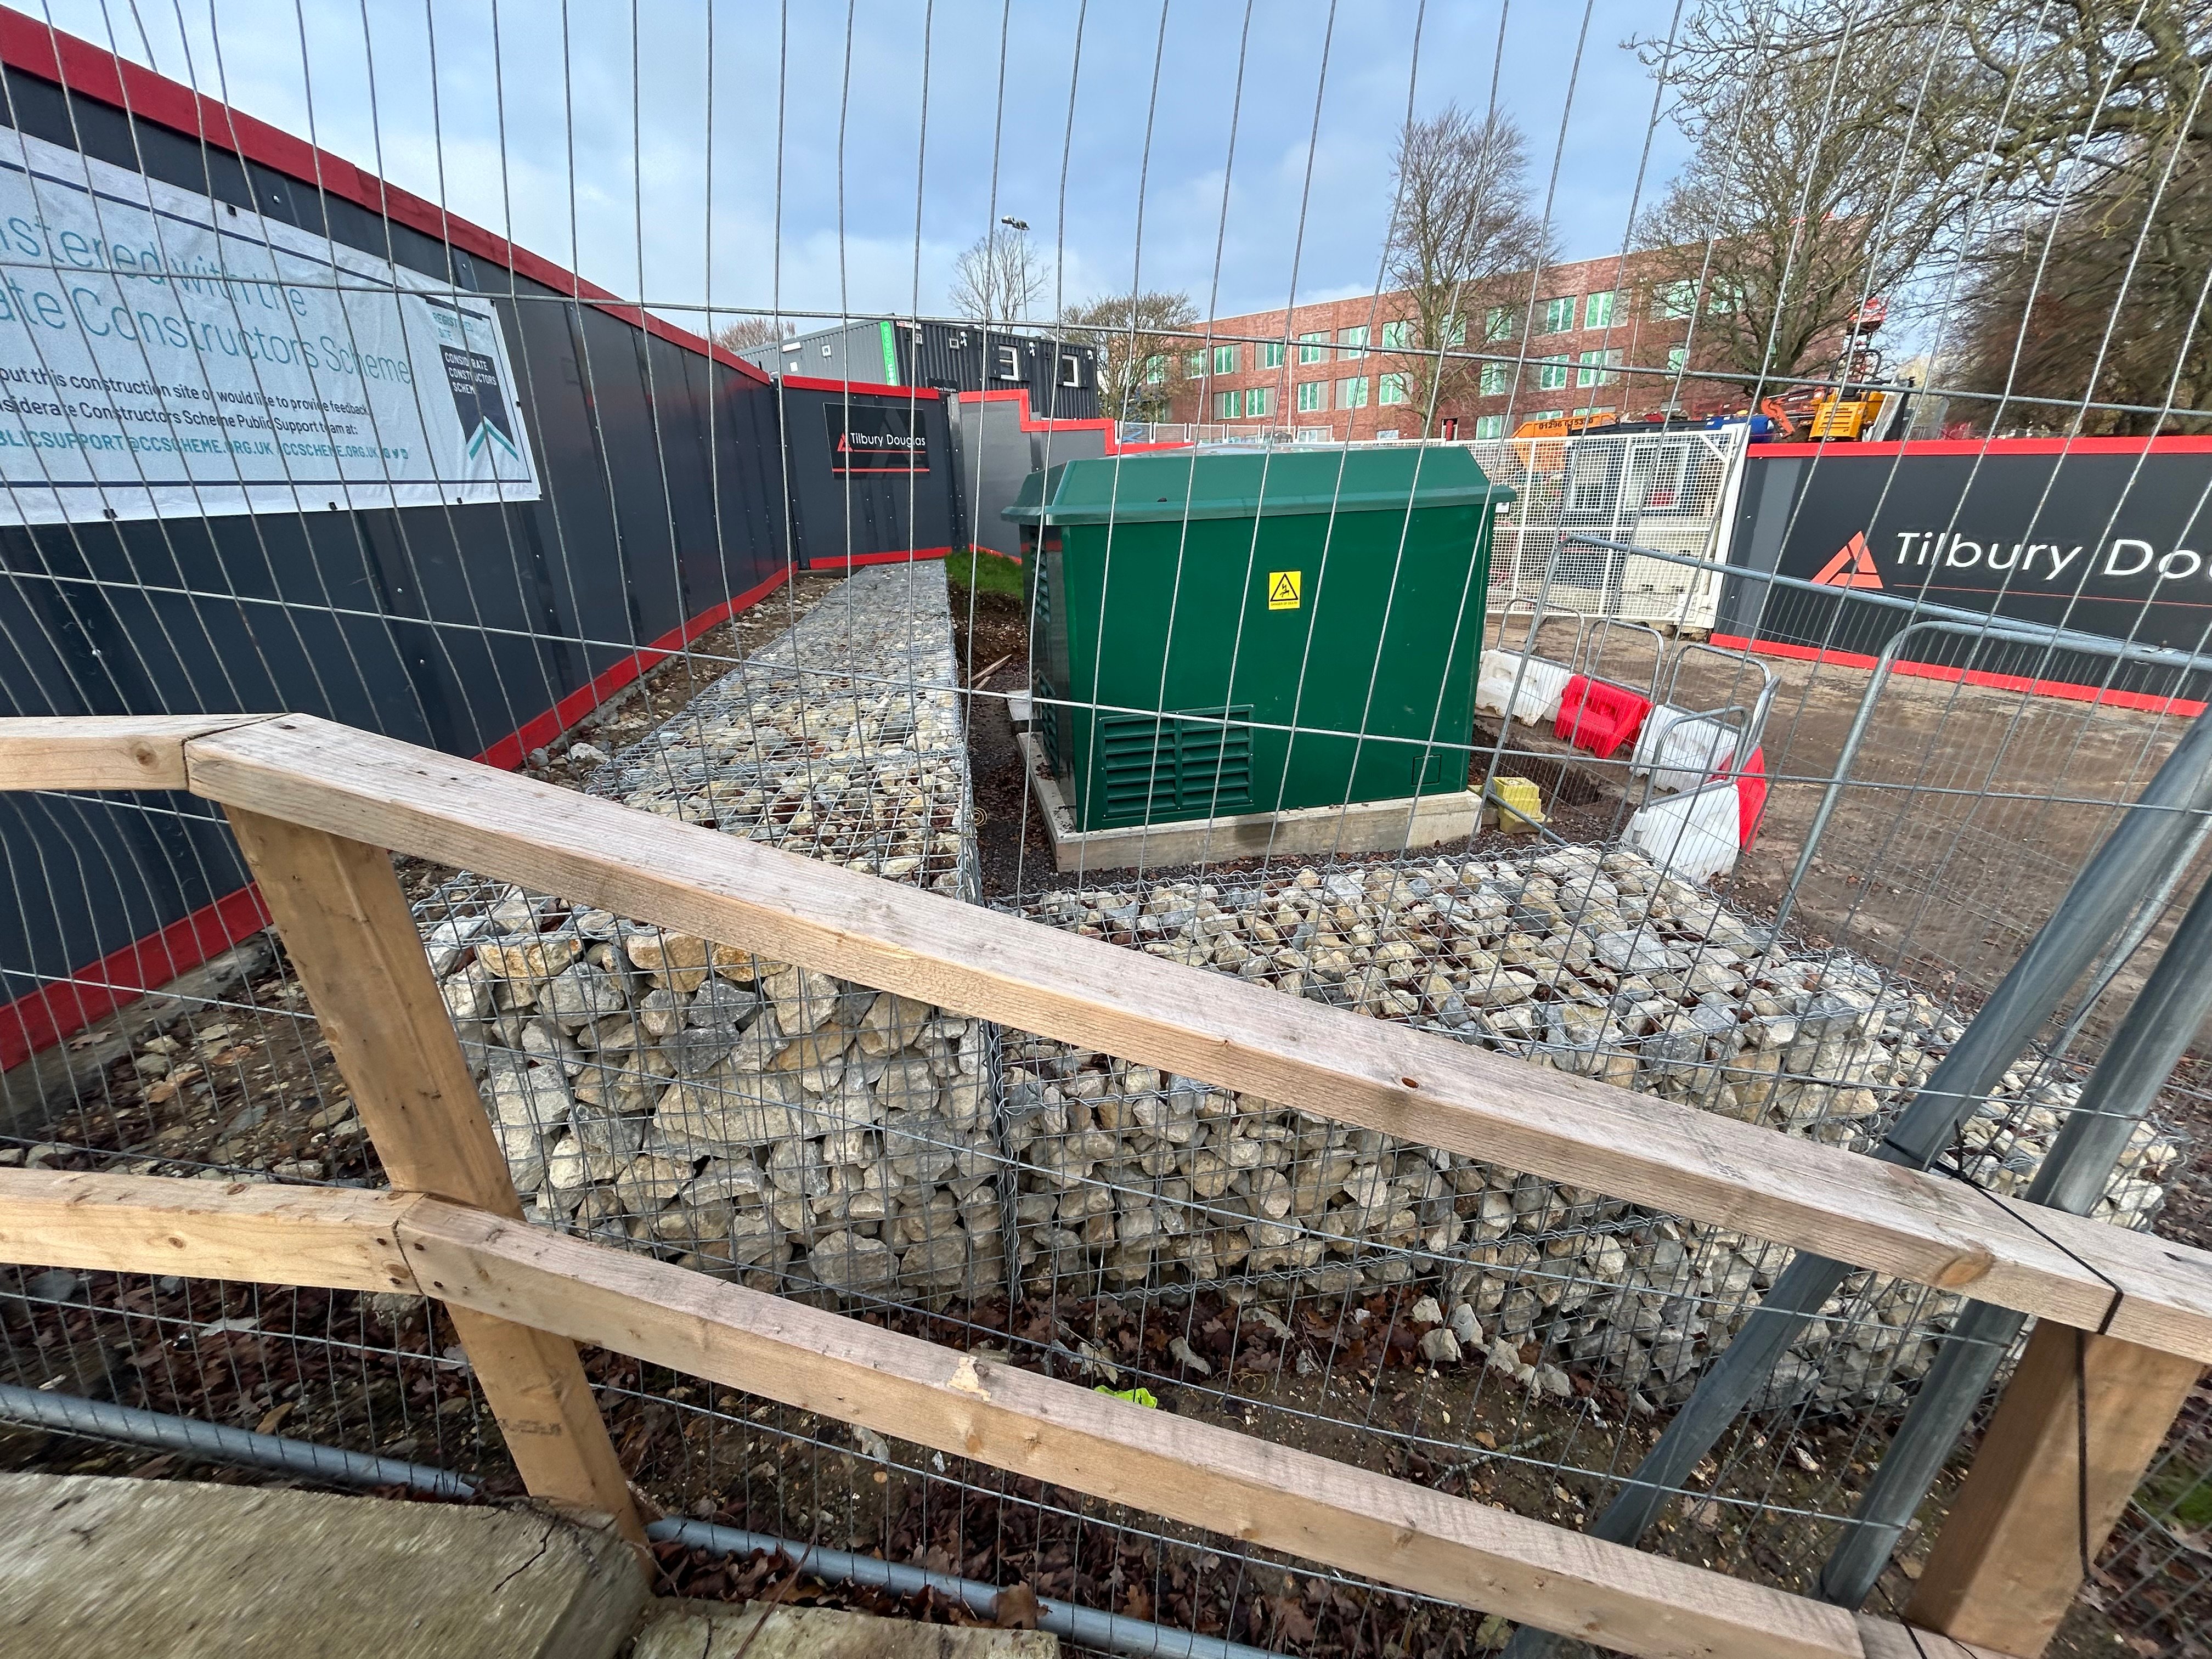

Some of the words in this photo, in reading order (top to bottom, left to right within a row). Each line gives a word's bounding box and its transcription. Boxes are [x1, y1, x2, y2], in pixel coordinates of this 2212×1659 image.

[170, 255, 251, 305] with
[252, 273, 307, 317] the
[72, 287, 319, 368] Constructors
[320, 336, 411, 385] Scheme
[444, 352, 489, 371] CONSIDRATE
[448, 366, 498, 386] CONSTUCTORS
[452, 381, 478, 396] SCHEM
[31, 368, 67, 387] this
[70, 376, 172, 397] construction
[172, 384, 200, 399] site
[216, 390, 255, 405] would
[253, 391, 275, 407] lie
[275, 396, 289, 408] to
[329, 400, 371, 416] feedback
[79, 401, 182, 424] Constructors
[182, 410, 236, 427] Scheme
[236, 414, 273, 430] Public
[274, 417, 318, 435] Support
[318, 421, 346, 434] tam
[346, 424, 359, 435] at:
[1539, 421, 1562, 430] 01296
[850, 432, 884, 447] Tilbury
[886, 433, 926, 448] Douglas
[1895, 531, 2084, 582] Tilbury
[2103, 538, 2212, 580] Do
